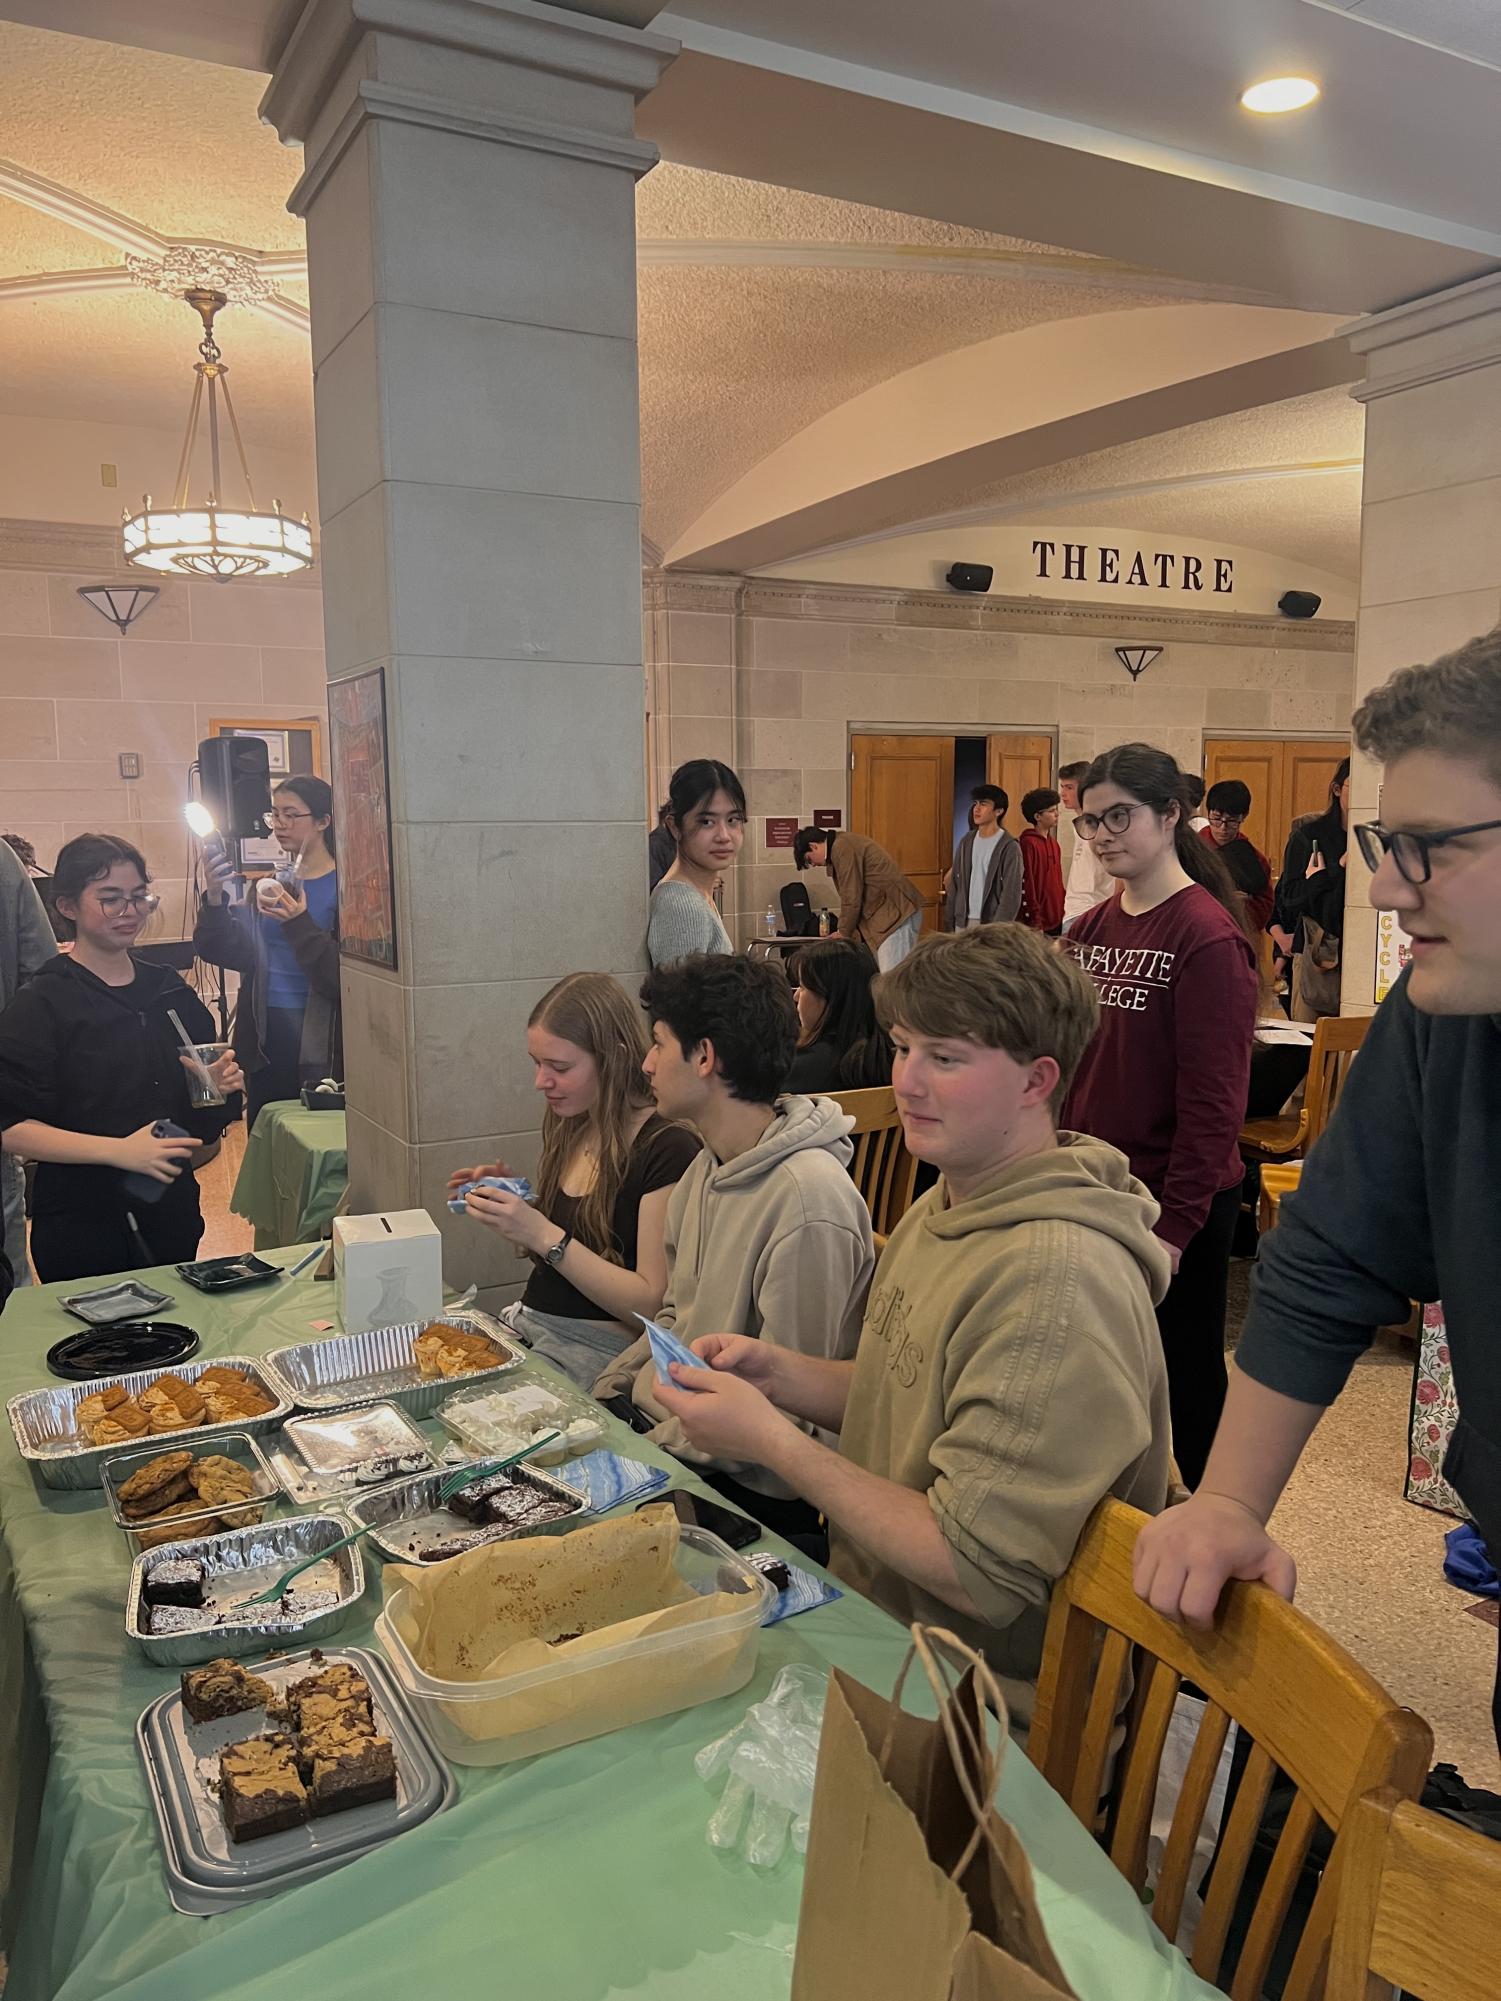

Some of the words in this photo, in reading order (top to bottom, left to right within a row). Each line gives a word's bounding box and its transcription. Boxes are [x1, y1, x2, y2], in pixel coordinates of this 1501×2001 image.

[1032, 540, 1233, 593] THEATRE
[1074, 945, 1175, 982] AFAYETTE
[1094, 983, 1149, 1011] LEGE
